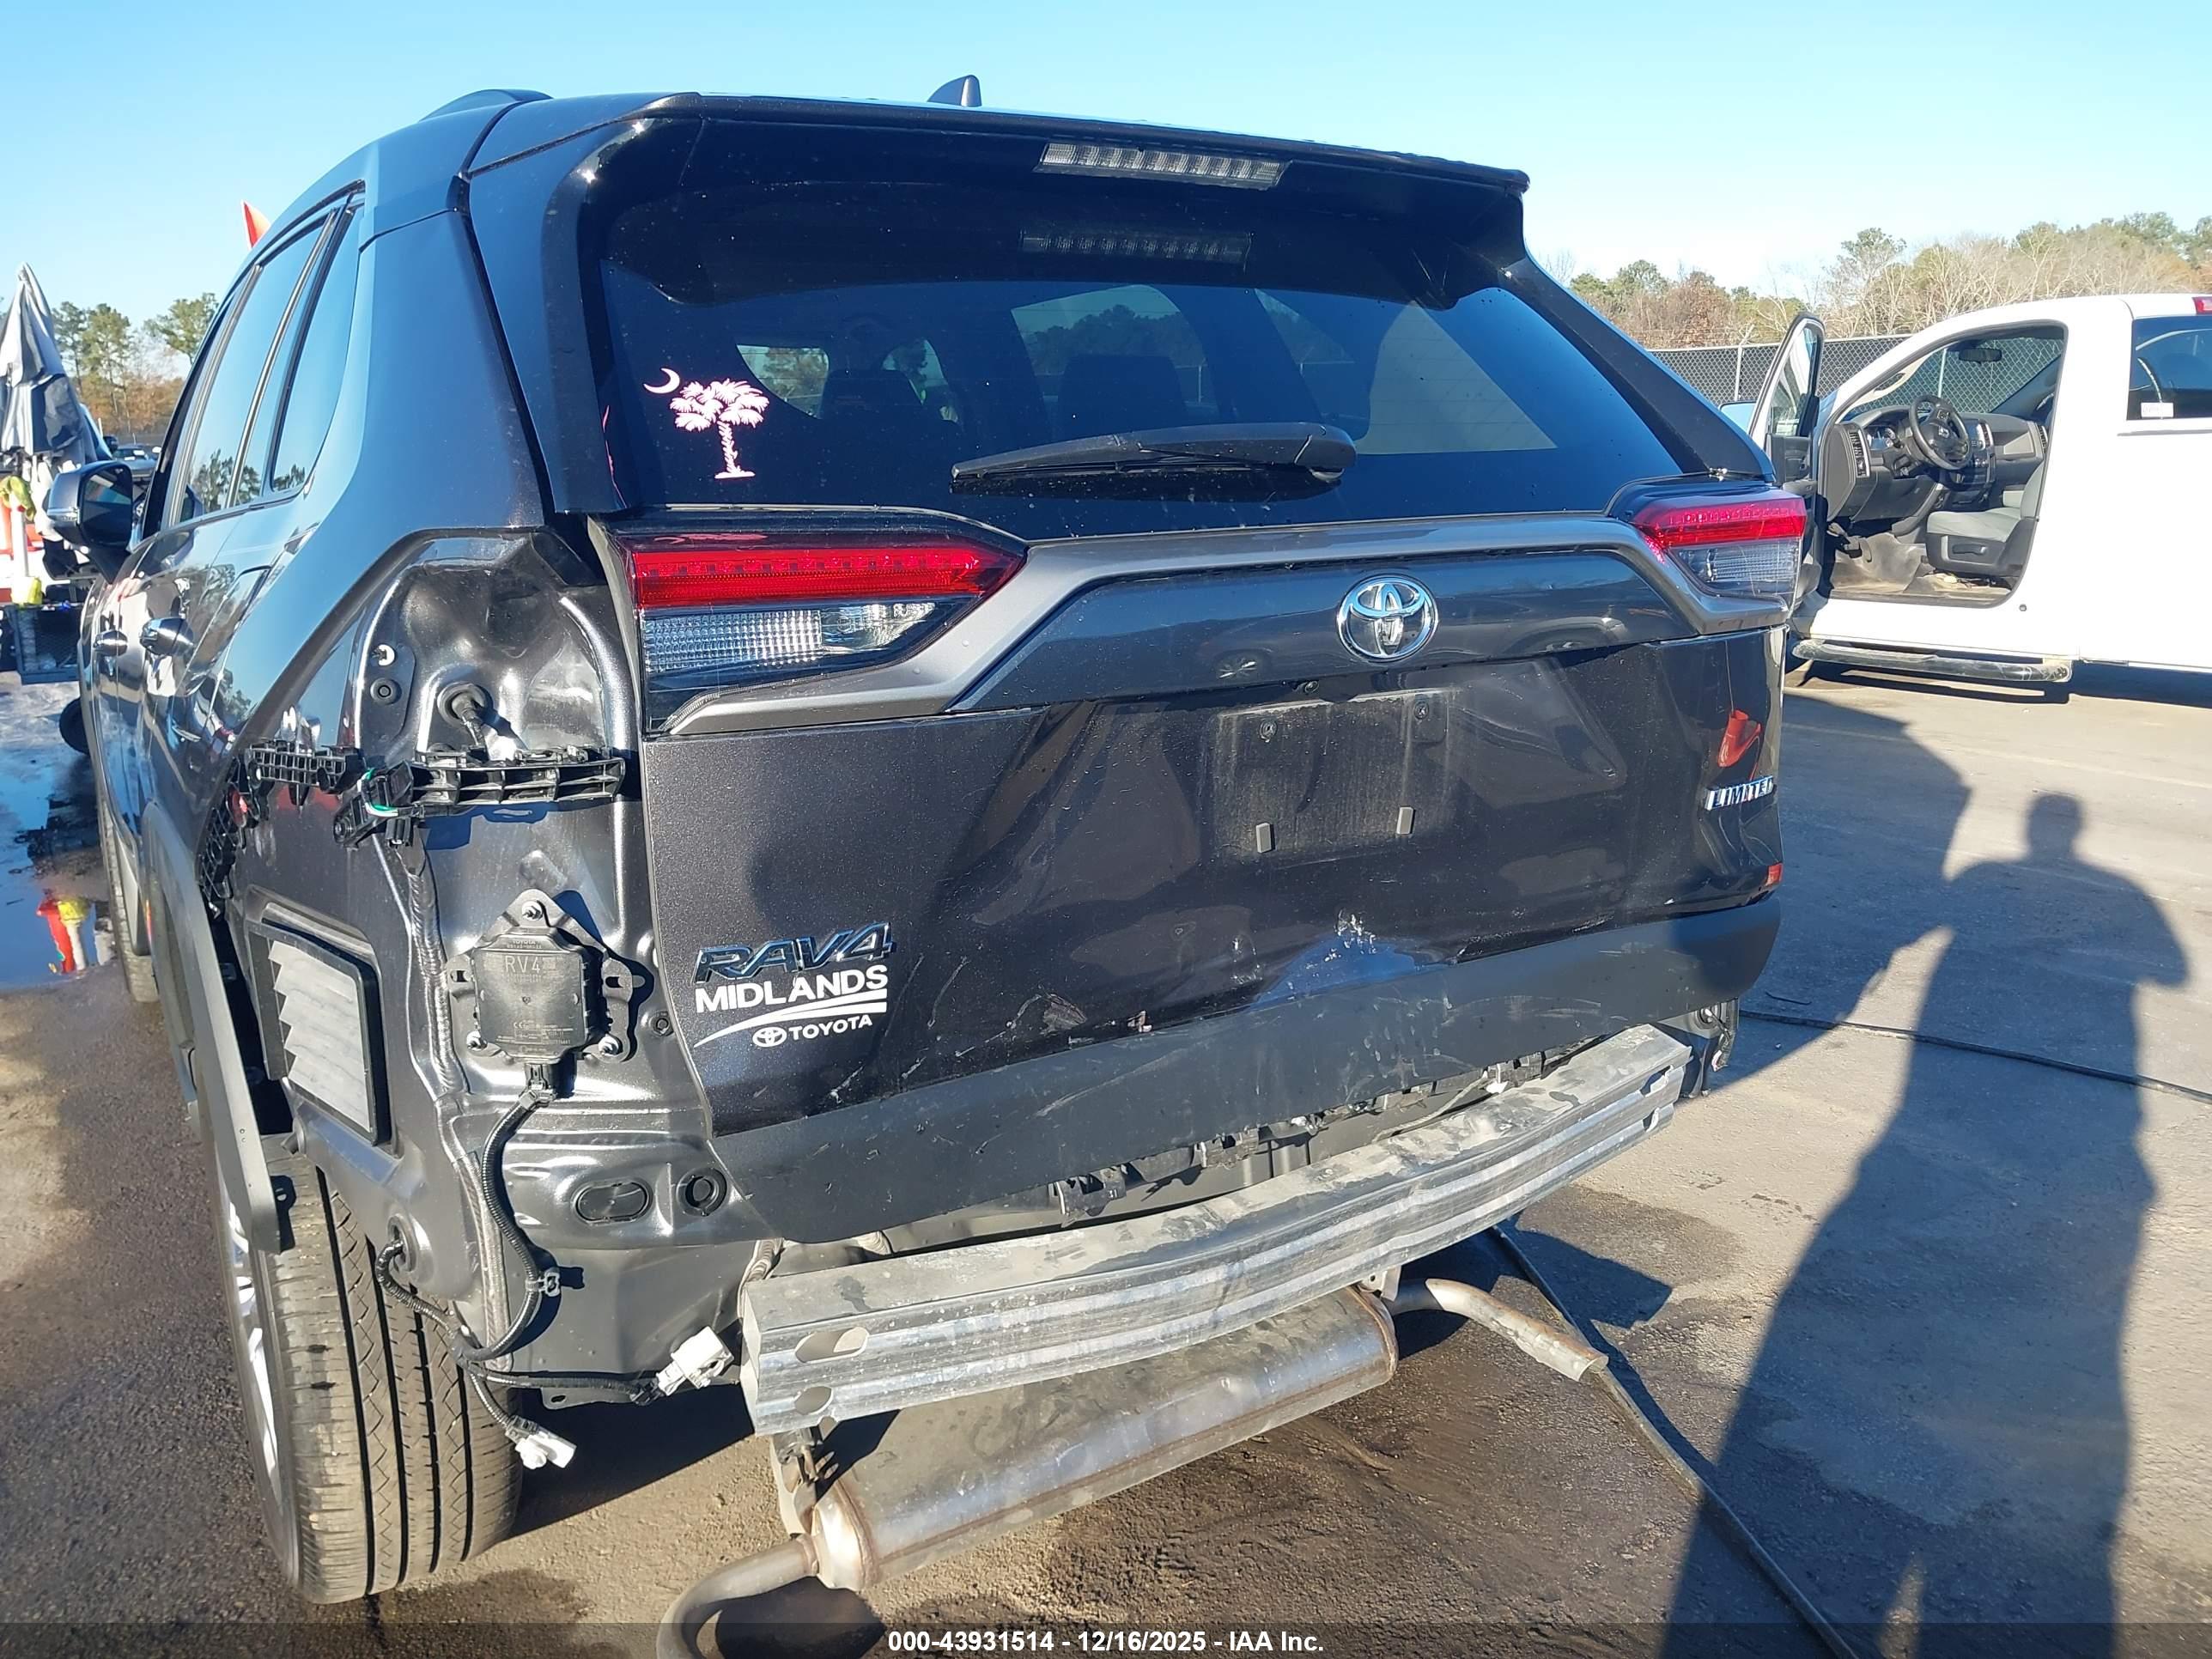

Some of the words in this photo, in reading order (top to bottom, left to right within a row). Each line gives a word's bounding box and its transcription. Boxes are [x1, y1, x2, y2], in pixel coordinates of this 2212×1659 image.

[691, 922, 894, 984] RAV4
[695, 964, 889, 1013] MIDLANDS
[789, 1014, 872, 1041] TOYOTA
